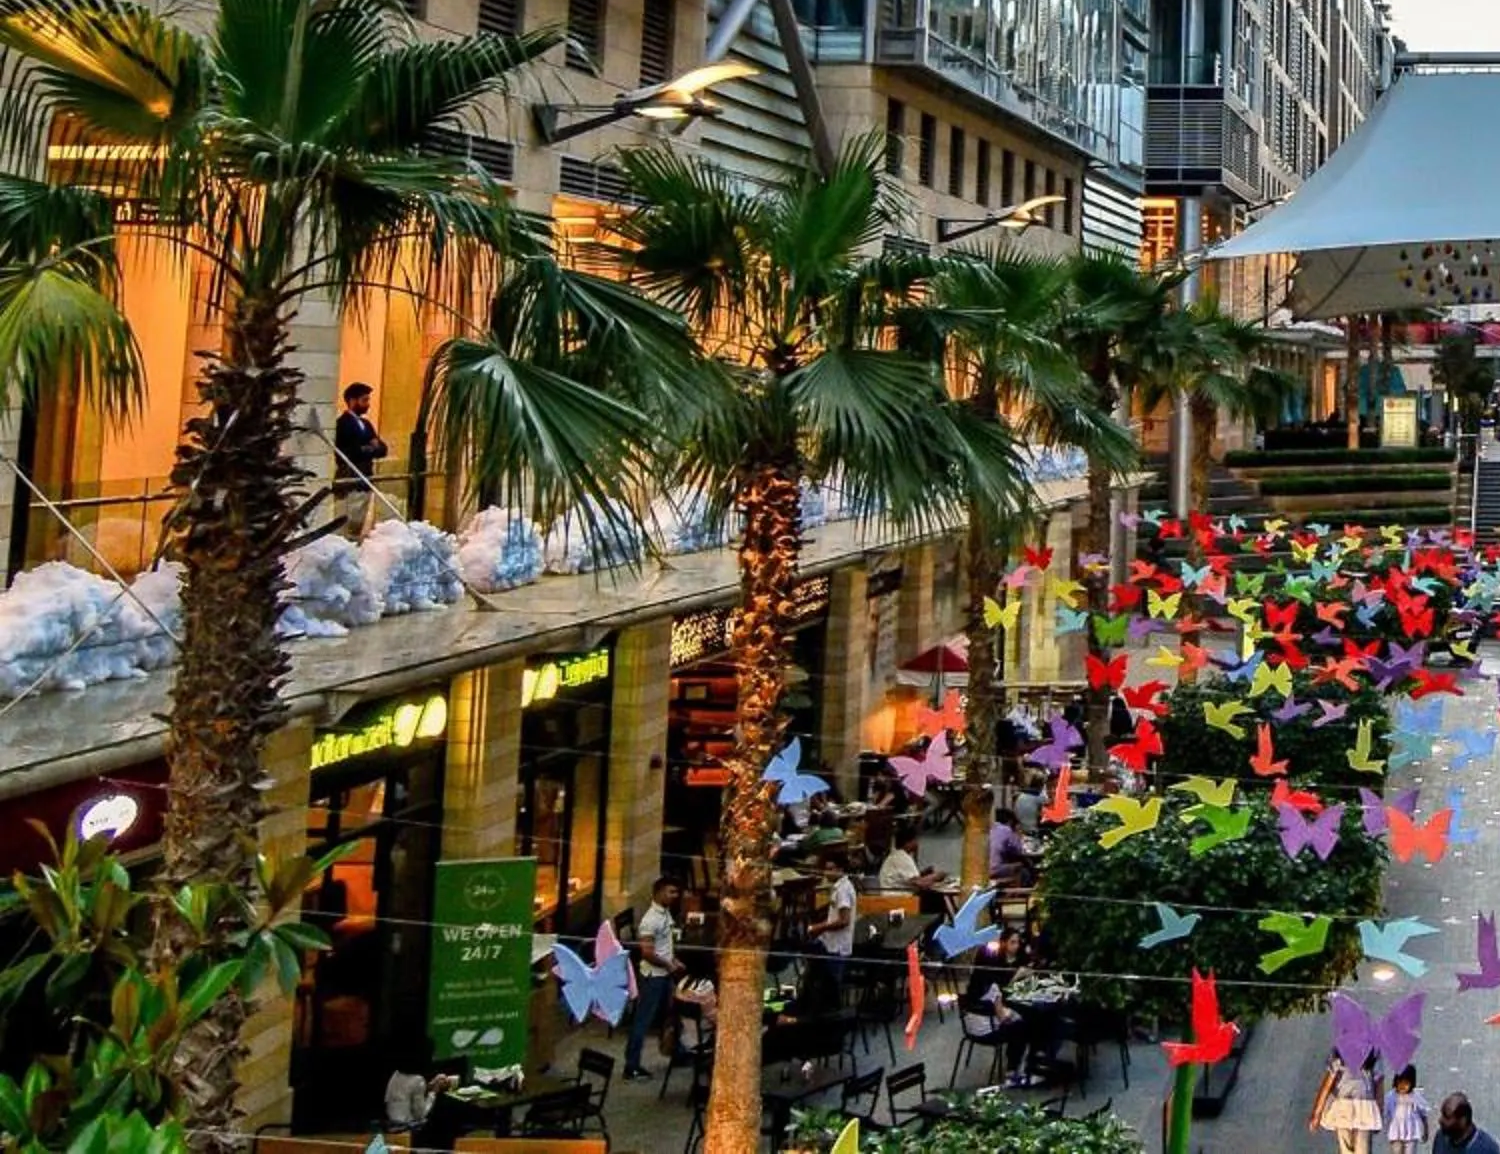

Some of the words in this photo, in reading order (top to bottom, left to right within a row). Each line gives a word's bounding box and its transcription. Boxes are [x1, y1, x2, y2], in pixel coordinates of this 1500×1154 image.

[442, 927, 472, 943] WE
[473, 923, 523, 942] OPEN
[460, 945, 503, 962] 24/7
